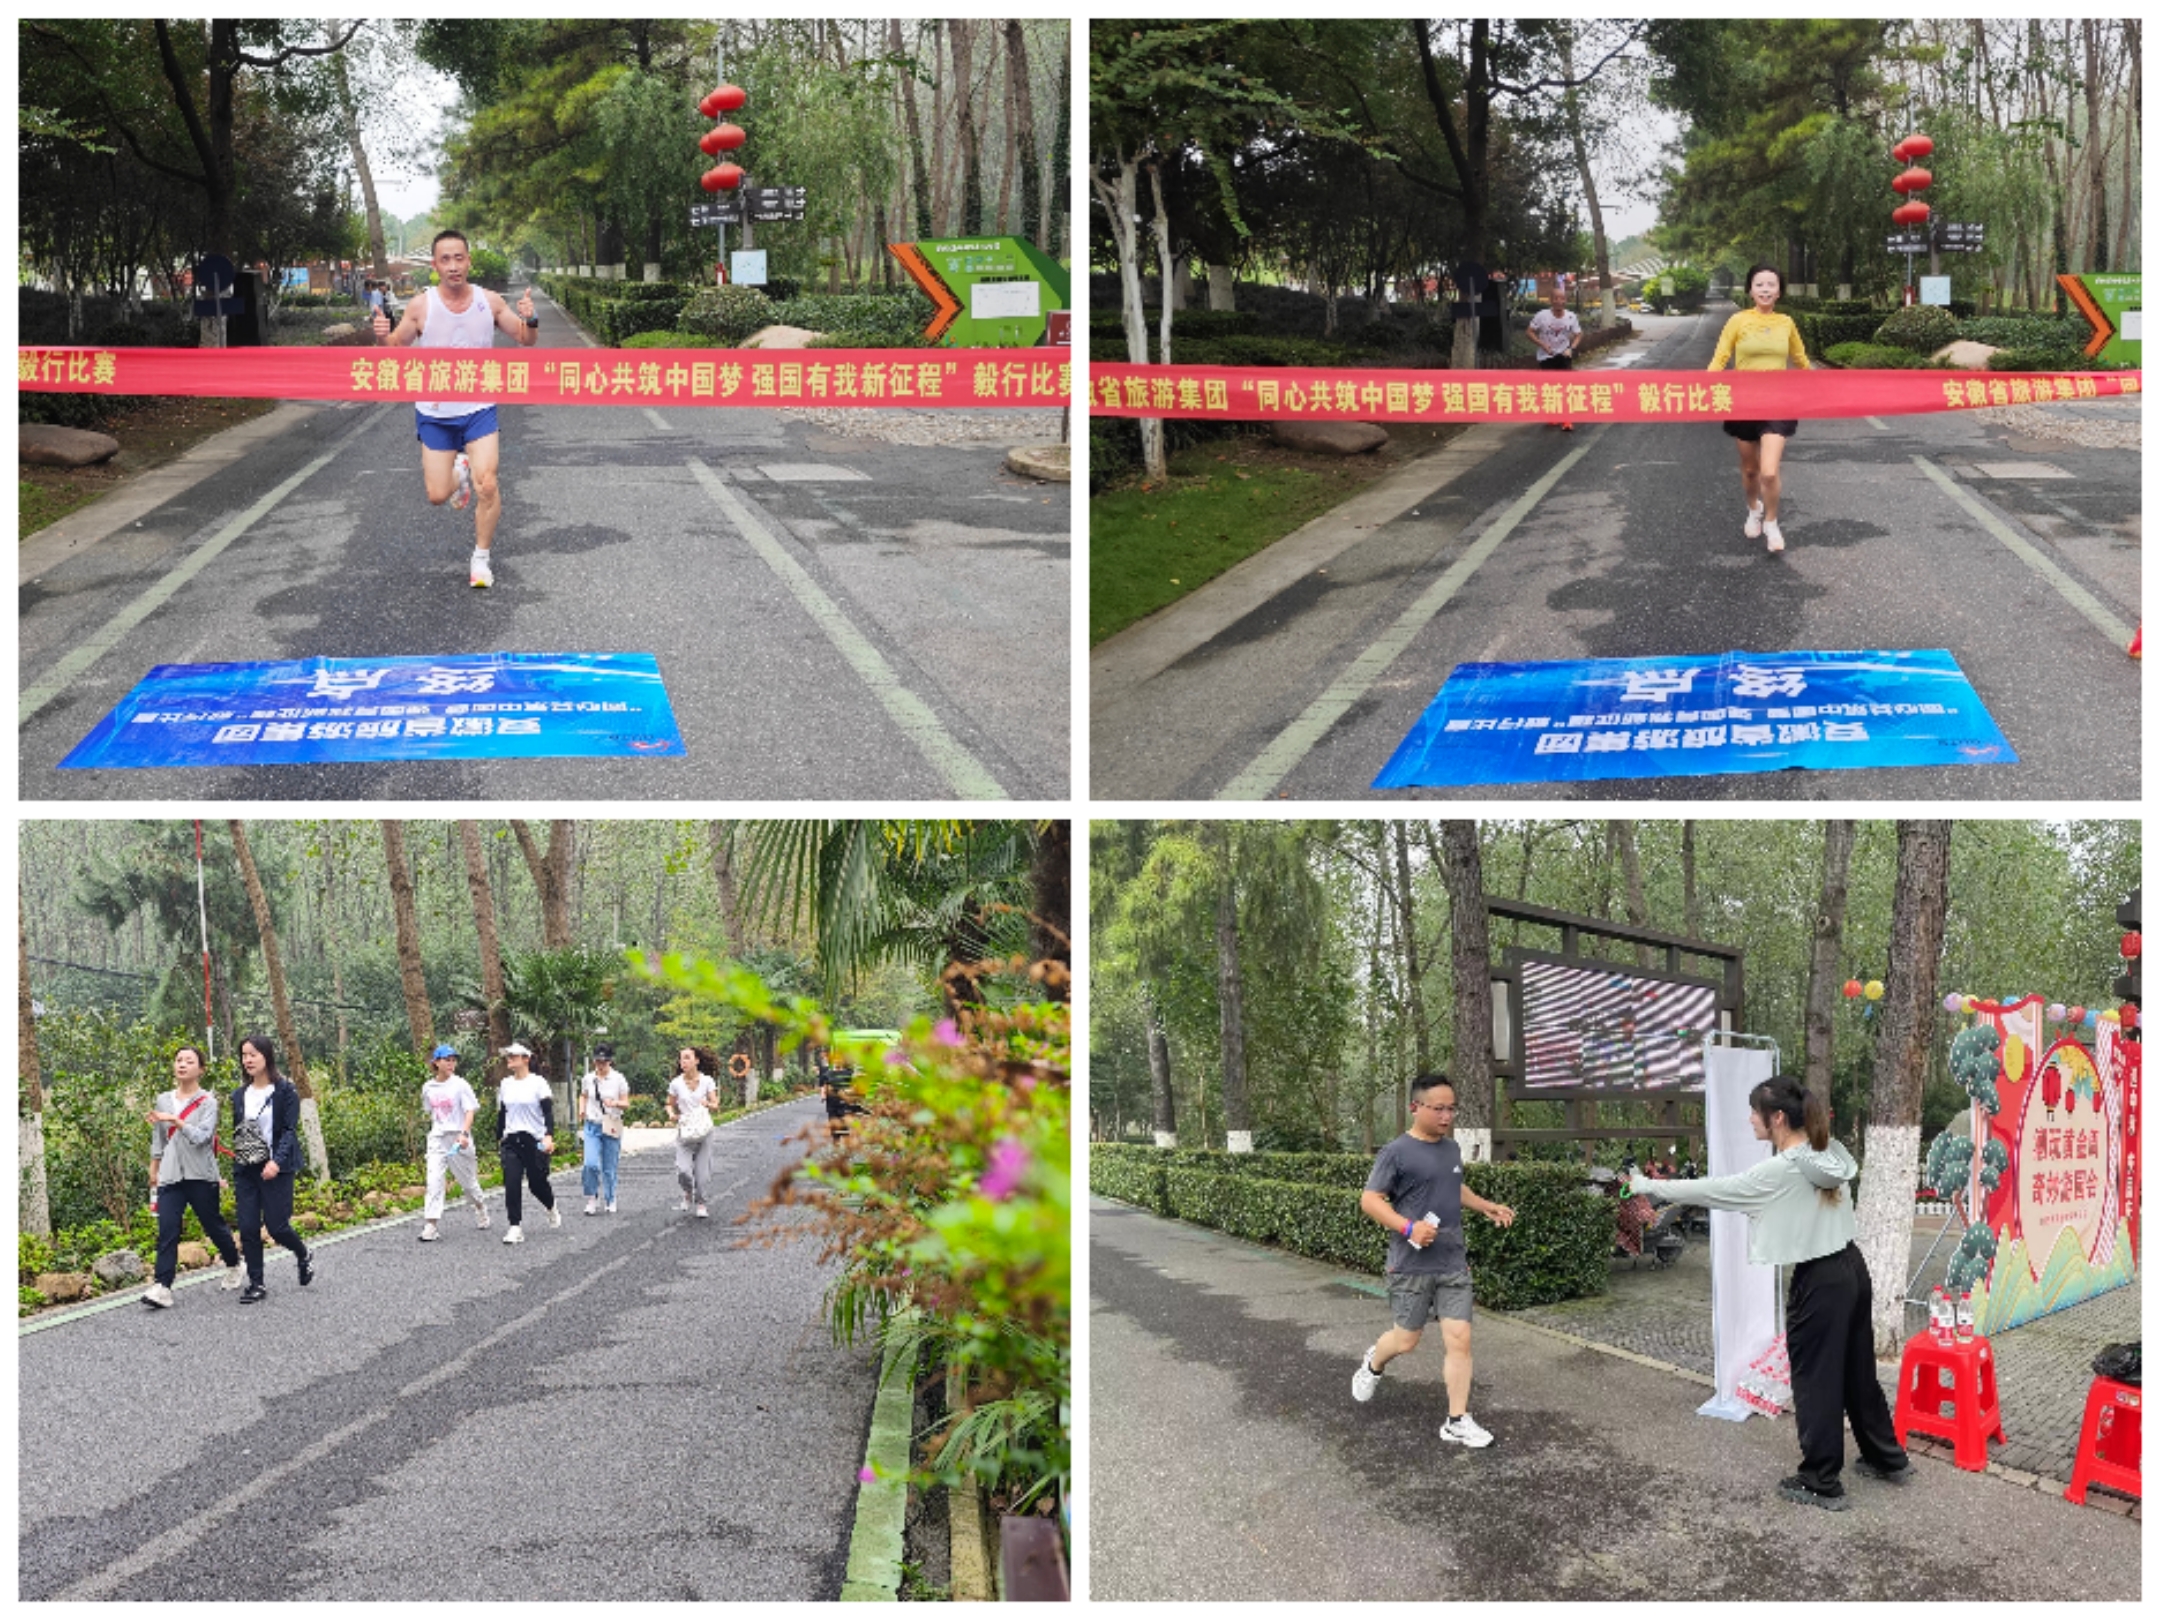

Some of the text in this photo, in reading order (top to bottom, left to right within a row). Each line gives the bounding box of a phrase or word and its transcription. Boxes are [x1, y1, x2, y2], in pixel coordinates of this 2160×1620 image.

[17, 352, 116, 385] 毅行比赛
[351, 357, 529, 394] 安徽省旅游集团
[1638, 382, 1733, 414] 毅行比赛
[211, 716, 542, 744] 安徽省旅游集团
[1533, 719, 1870, 755] 安徽省旅游集团
